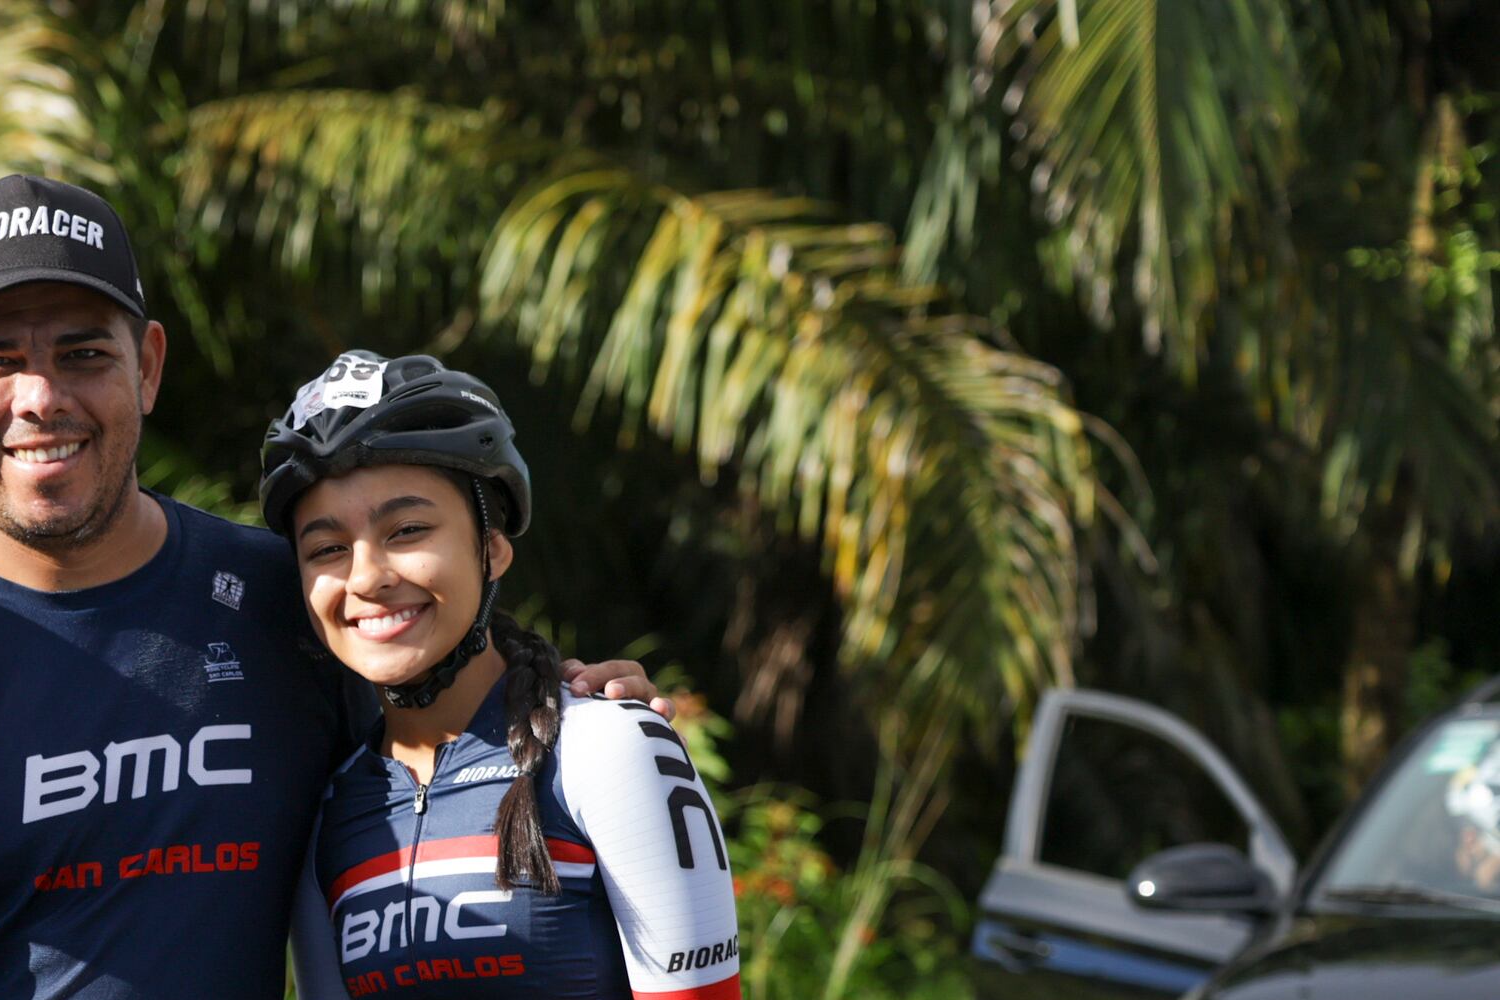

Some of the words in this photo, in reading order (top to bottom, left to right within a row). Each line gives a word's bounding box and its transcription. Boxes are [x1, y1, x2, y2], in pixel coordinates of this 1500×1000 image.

[22, 723, 252, 824] BMC
[453, 765, 519, 784] BIORAC
[118, 842, 260, 880] CARLOS
[342, 890, 513, 965] BMC
[667, 934, 738, 973] BIORAC
[346, 971, 389, 998] SAN
[393, 954, 526, 987] CARLOS
